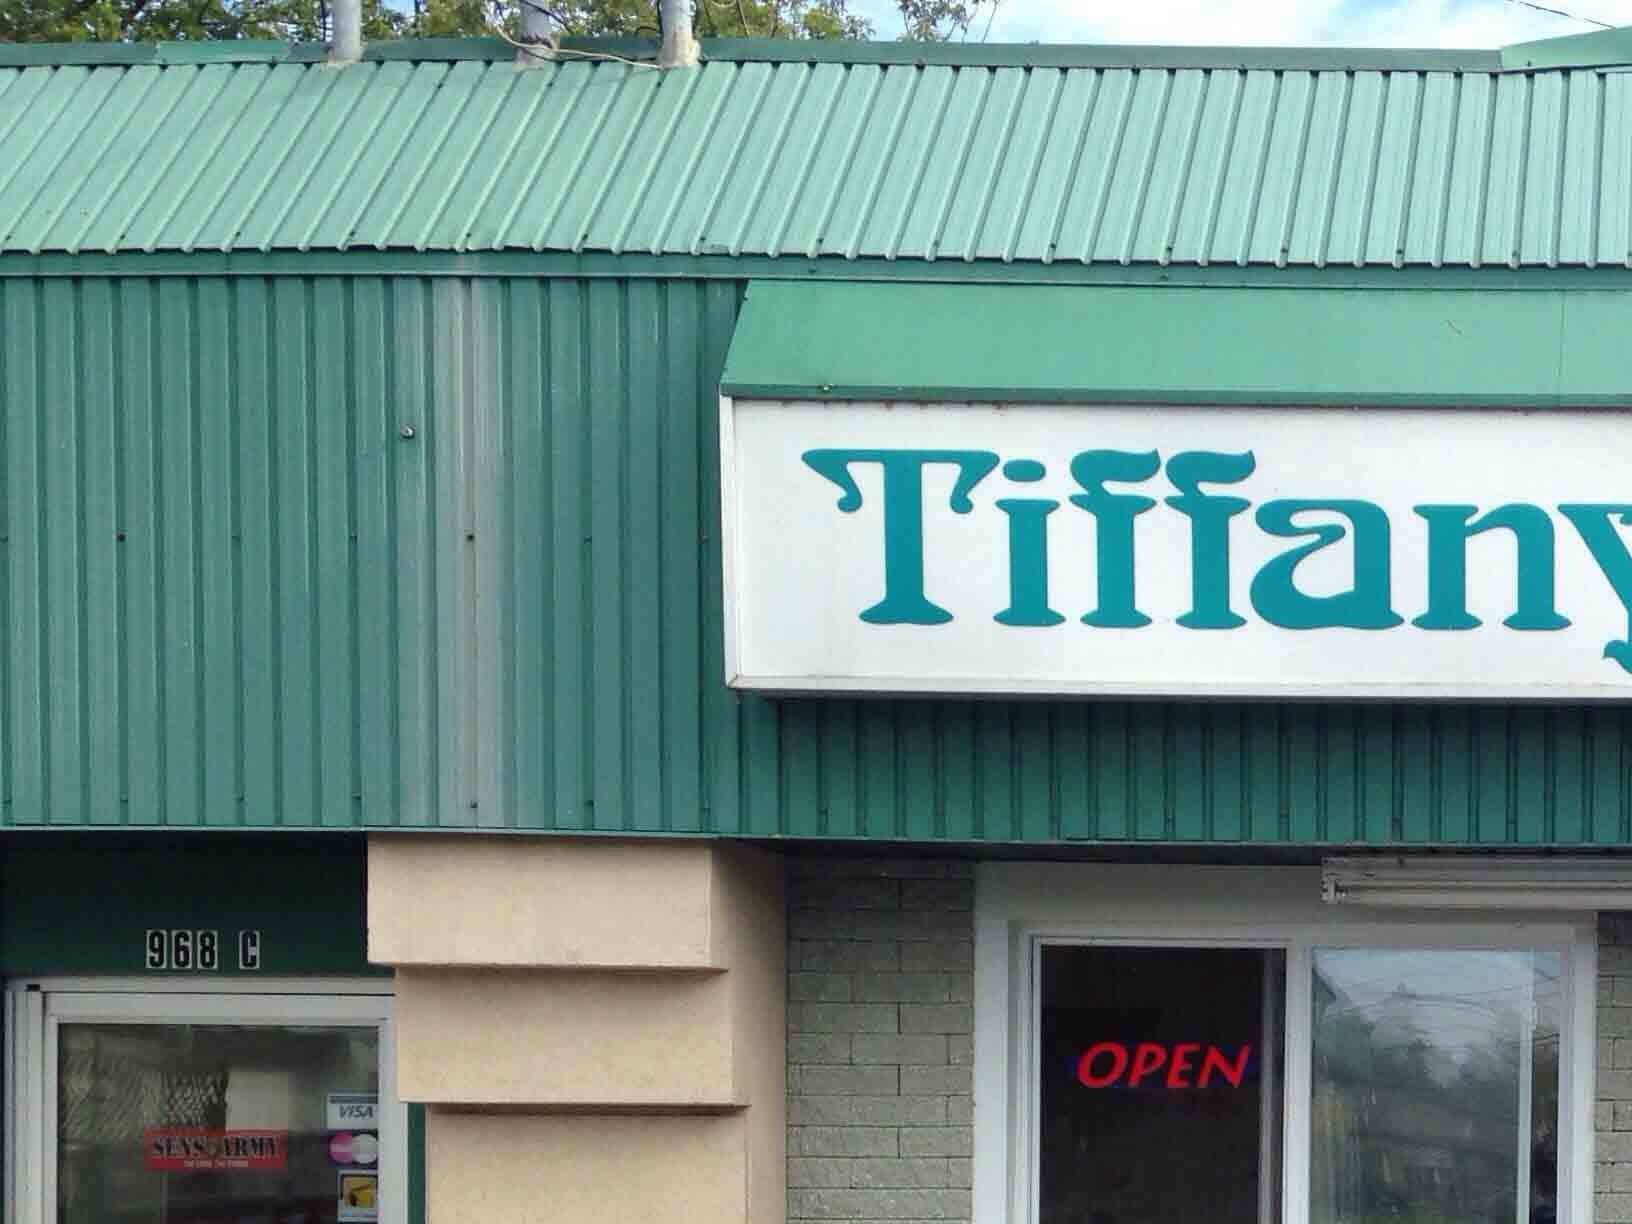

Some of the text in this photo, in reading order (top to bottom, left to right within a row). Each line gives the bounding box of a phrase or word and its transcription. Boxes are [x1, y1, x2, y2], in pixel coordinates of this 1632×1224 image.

[146, 930, 260, 968] 968 C
[1077, 1040, 1251, 1088] OPEN
[339, 1105, 374, 1118] VISA
[221, 1136, 279, 1158] ARMY
